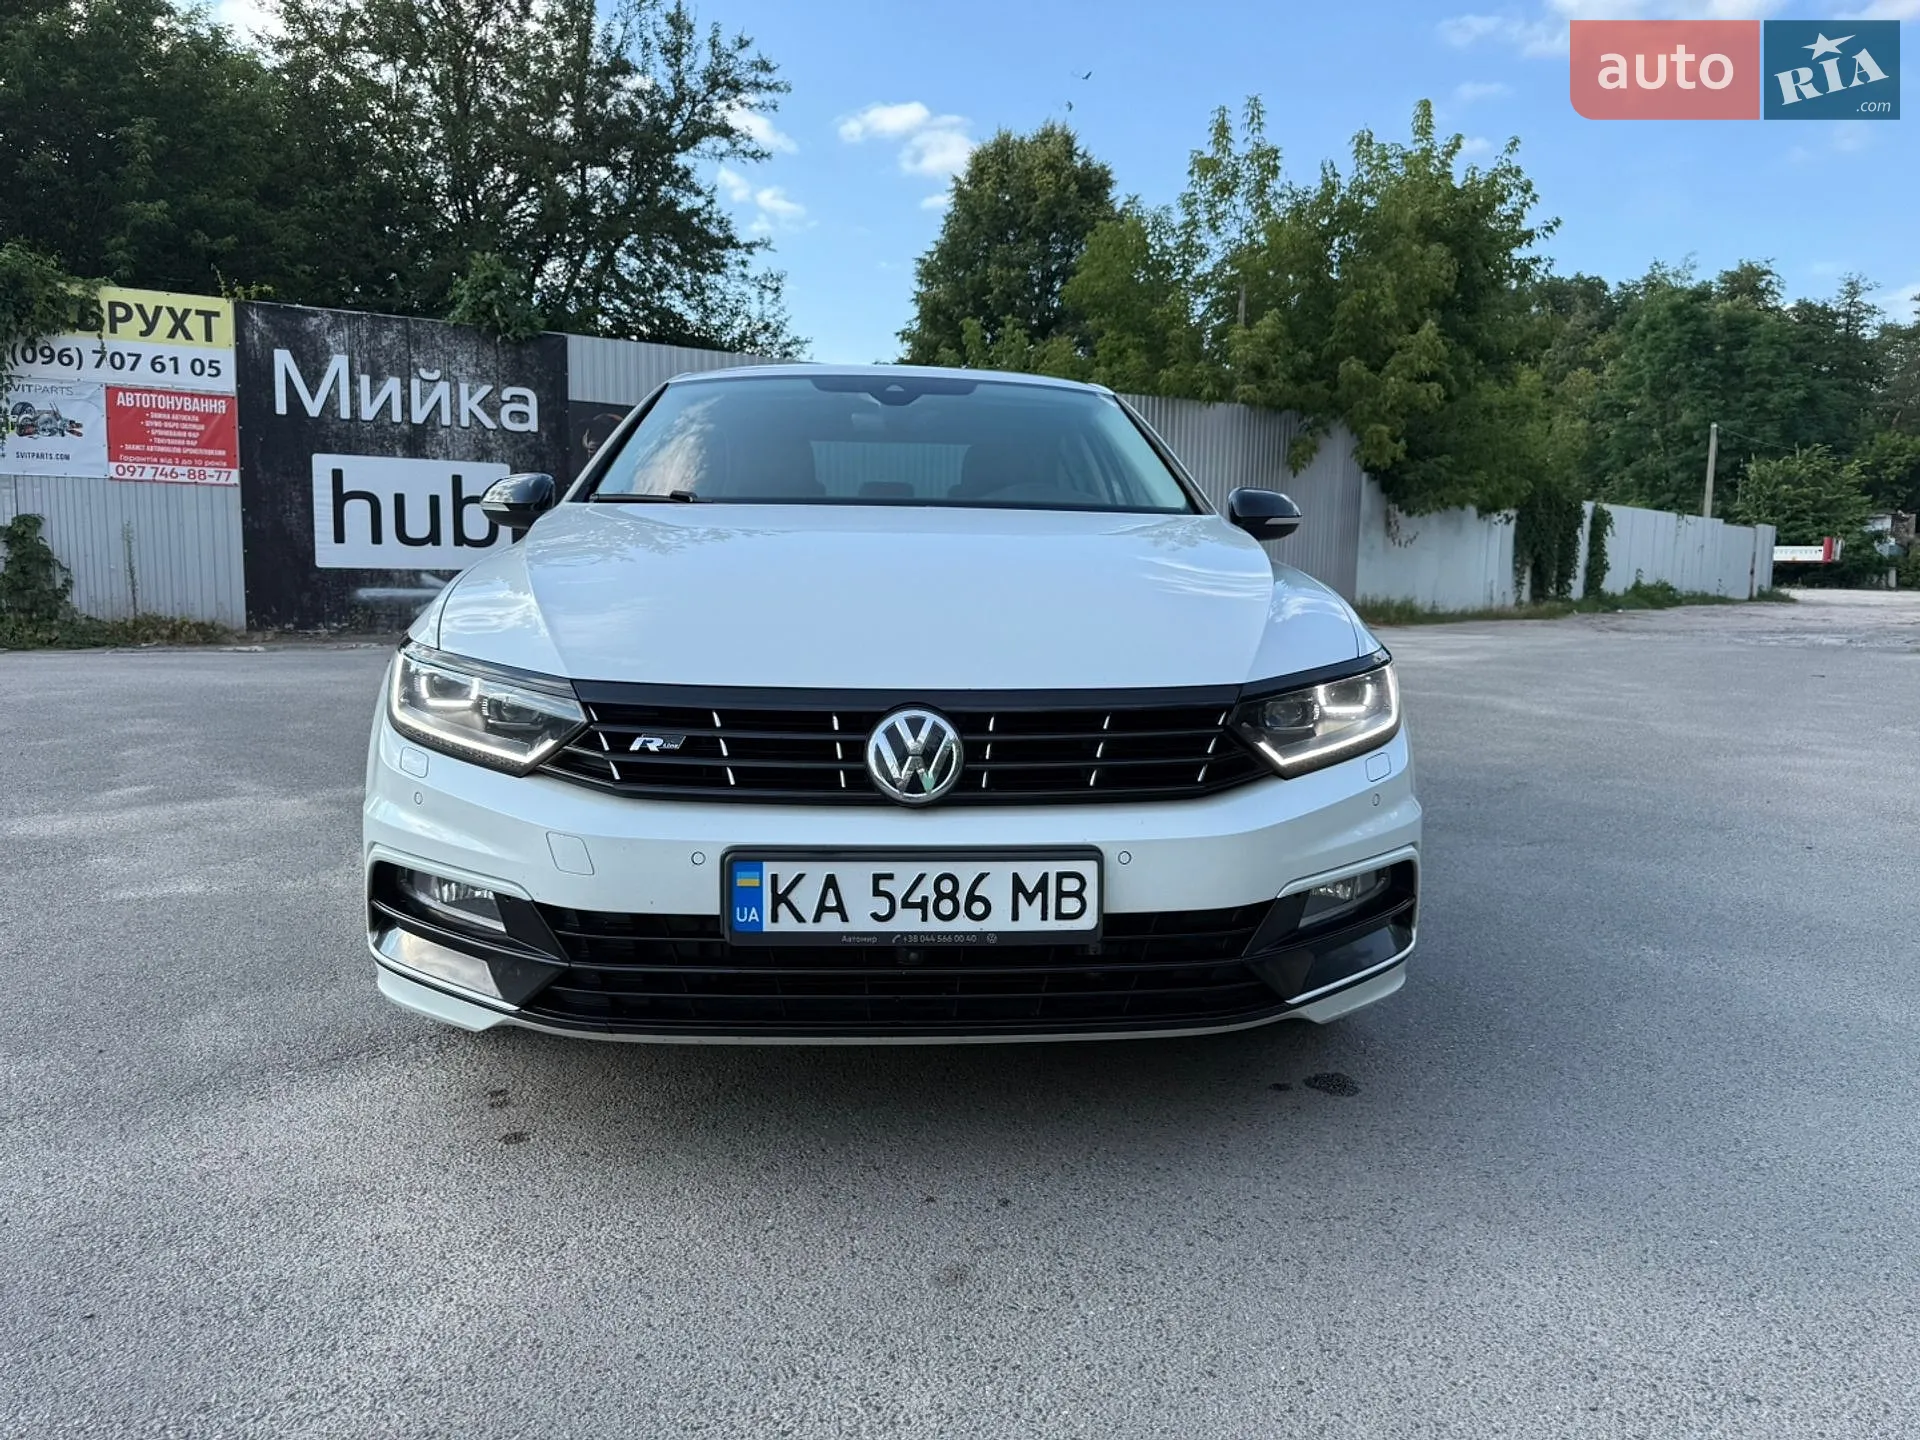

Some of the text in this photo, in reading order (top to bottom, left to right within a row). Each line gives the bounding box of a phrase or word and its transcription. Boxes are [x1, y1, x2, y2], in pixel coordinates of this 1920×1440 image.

[11, 342, 222, 378] (096) 707 61 05
[116, 391, 227, 414] АВТОТОНУВАННЯ
[273, 348, 539, 433] Мийка
[15, 451, 70, 461] SVITPARTS.COM
[115, 464, 232, 482] 097 746-88-77
[331, 468, 499, 548] hub
[769, 871, 1088, 924] KA 5486 MB
[736, 907, 760, 923] UA
